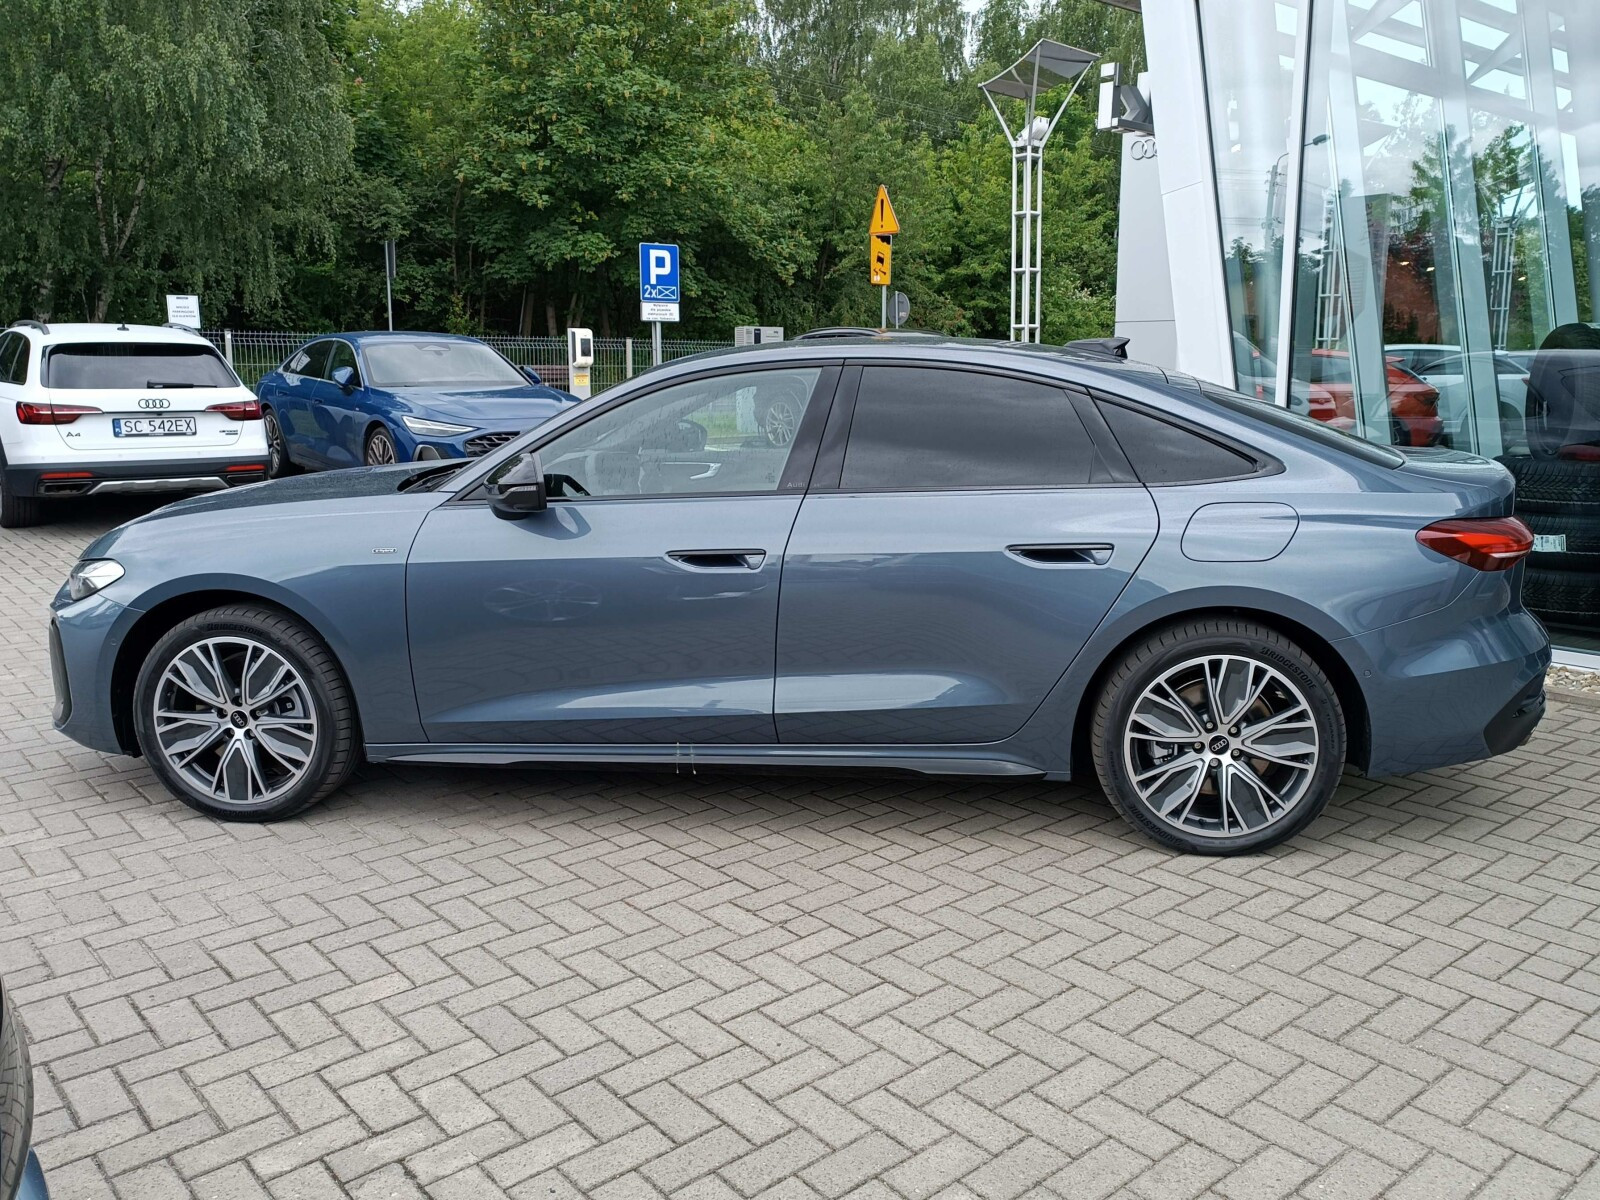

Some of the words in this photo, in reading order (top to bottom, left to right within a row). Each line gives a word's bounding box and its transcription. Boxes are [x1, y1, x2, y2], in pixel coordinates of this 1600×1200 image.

[649, 249, 671, 285] P
[644, 285, 657, 298] 2x
[124, 420, 143, 433] SC
[148, 419, 193, 433] 542EX
[1260, 646, 1317, 690] BRIDGESTONE
[1127, 802, 1184, 846] BRIDGESTONE
